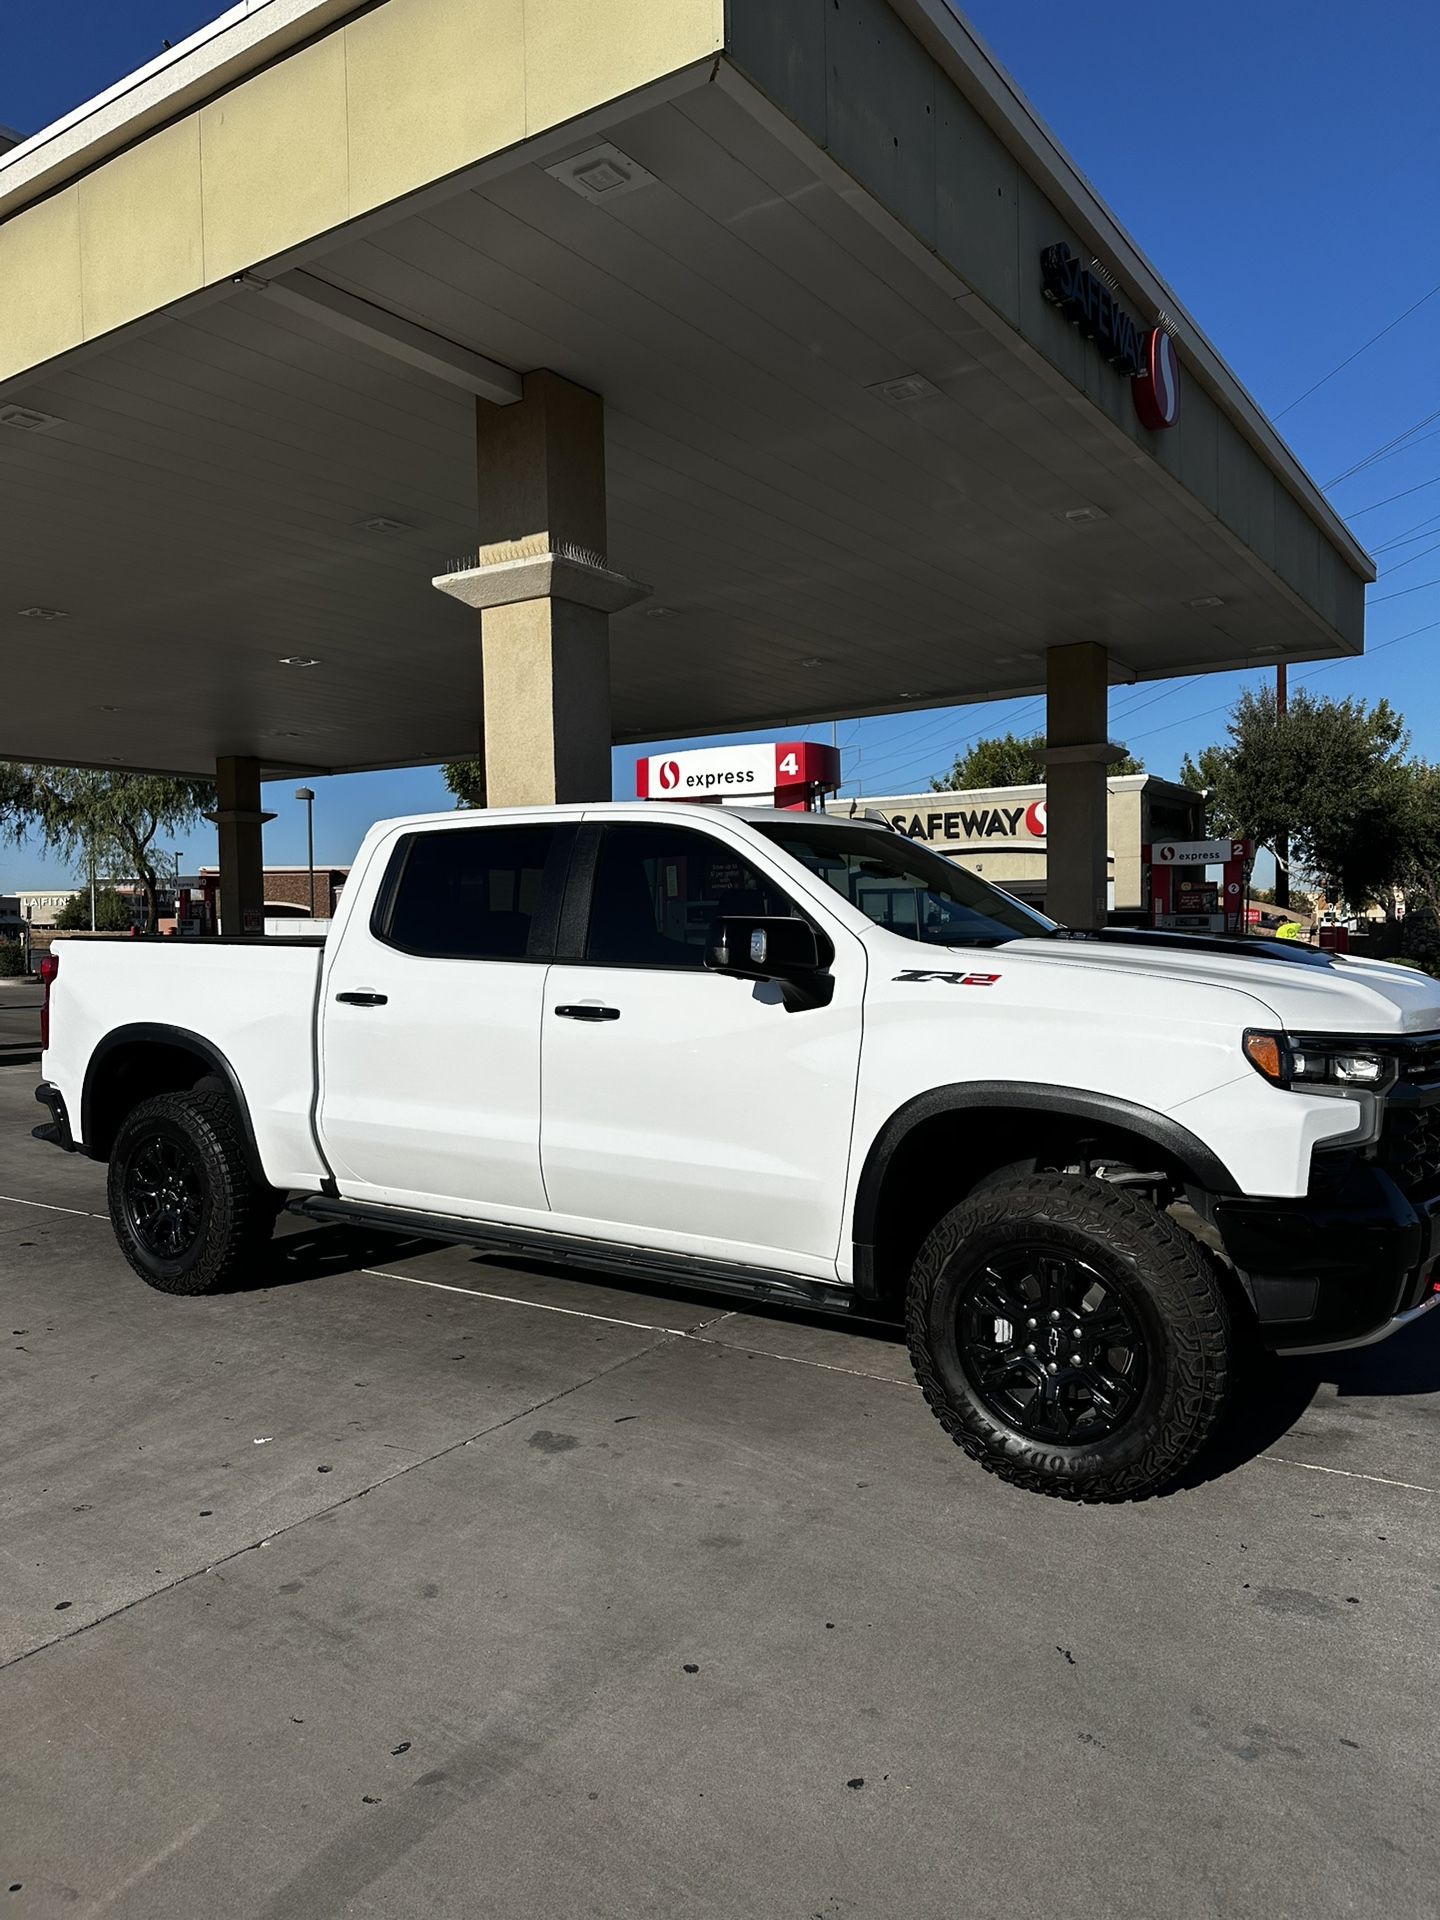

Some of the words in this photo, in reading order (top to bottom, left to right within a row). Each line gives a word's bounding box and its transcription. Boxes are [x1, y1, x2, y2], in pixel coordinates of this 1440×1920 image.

[686, 770, 754, 788] express
[779, 752, 799, 775] 4
[892, 807, 1025, 840] SAFEWAY
[1179, 852, 1220, 860] express
[1233, 844, 1243, 855] 2
[41, 897, 70, 906] FITN
[891, 970, 1002, 986] ZR2
